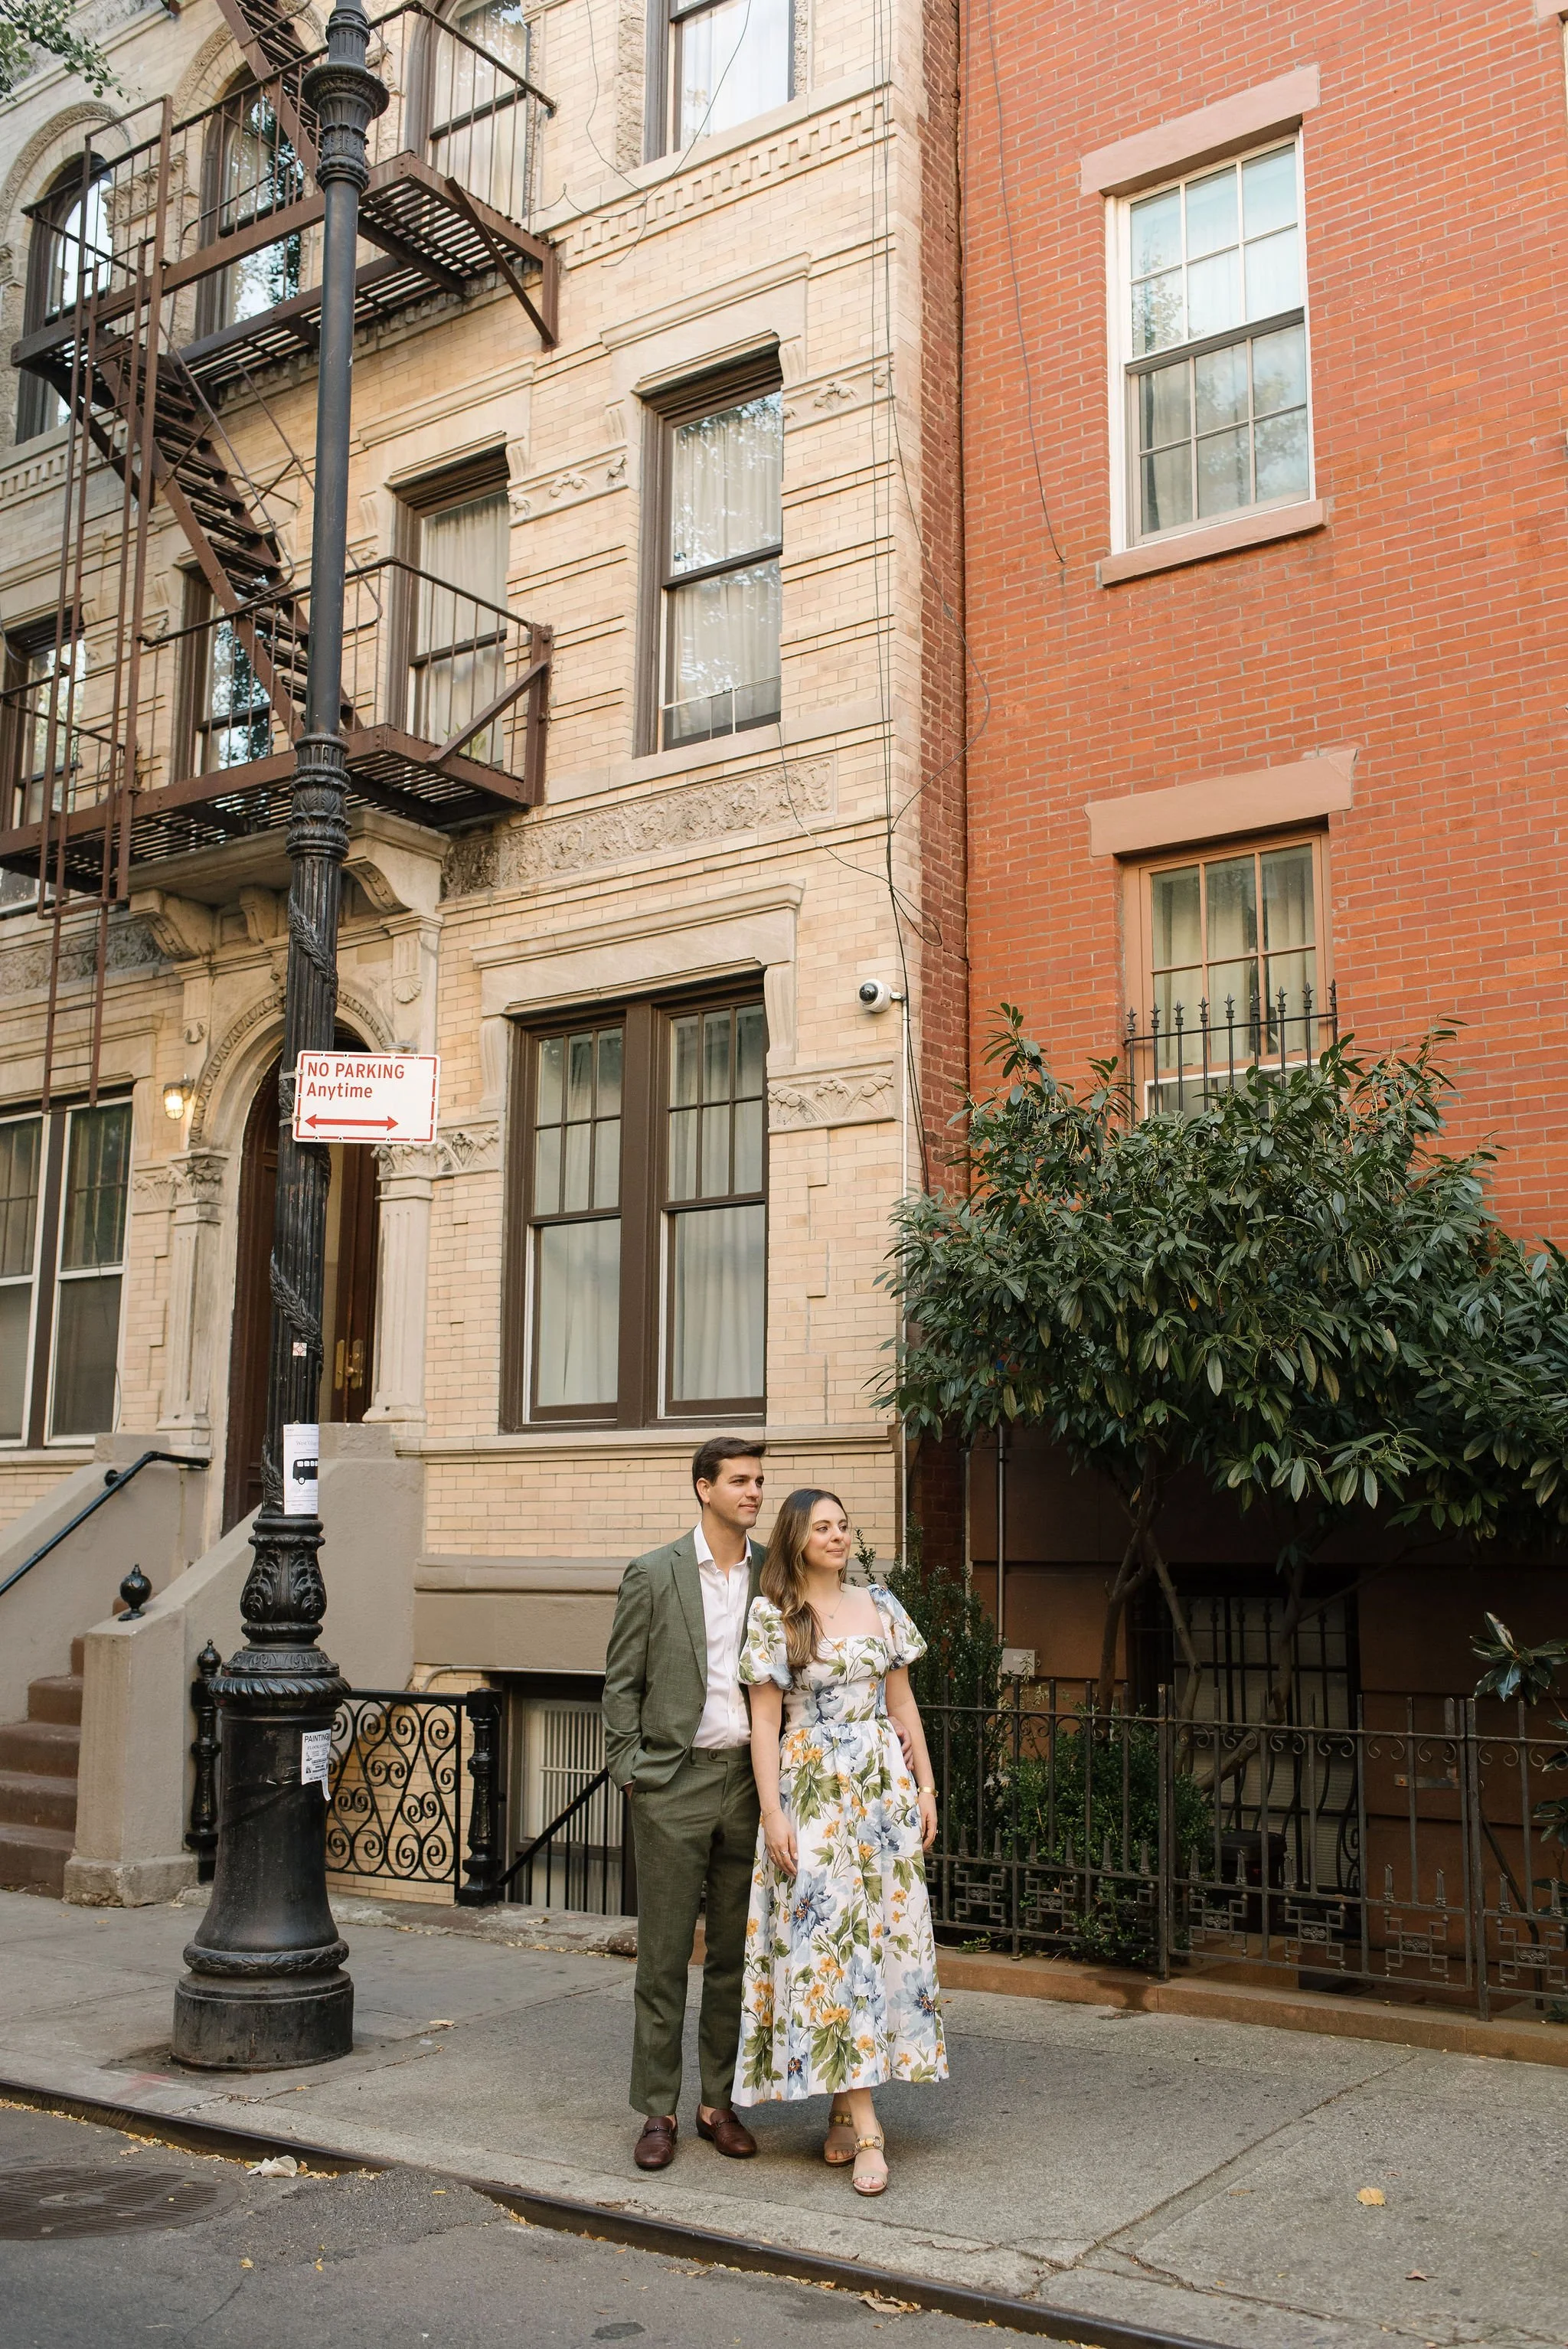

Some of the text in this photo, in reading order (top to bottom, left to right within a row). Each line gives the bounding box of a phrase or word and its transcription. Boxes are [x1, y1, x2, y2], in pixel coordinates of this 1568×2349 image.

[308, 1062, 404, 1079] NO PARKING
[307, 1082, 373, 1100] Anytime
